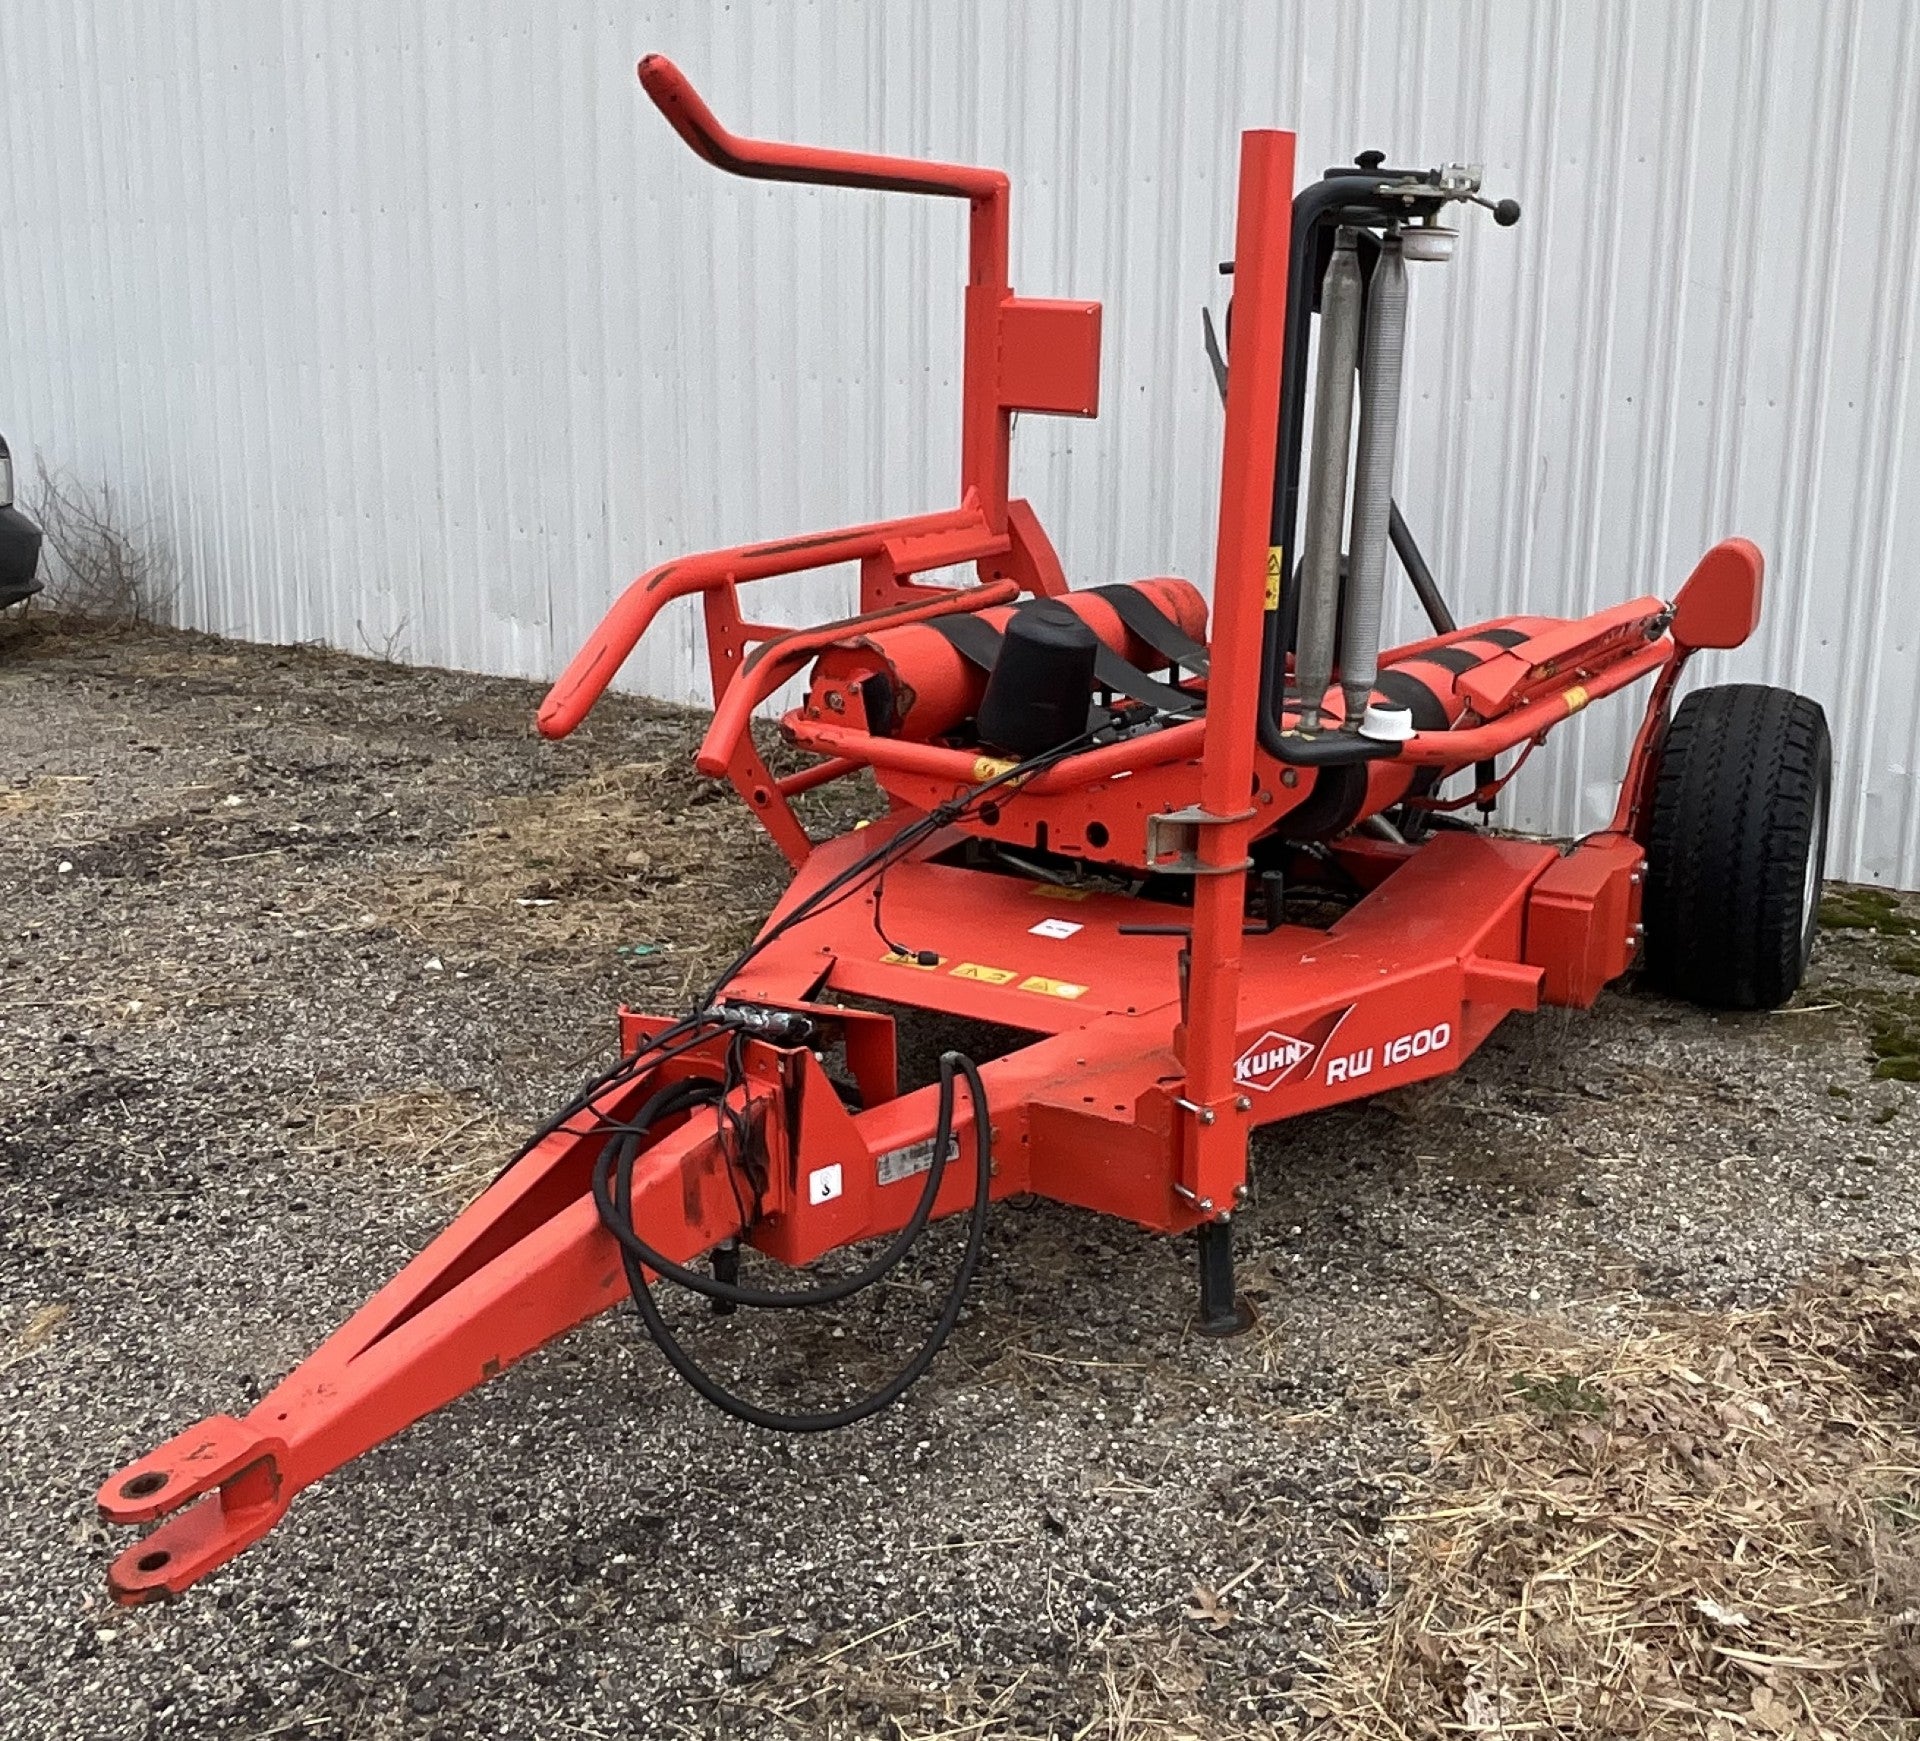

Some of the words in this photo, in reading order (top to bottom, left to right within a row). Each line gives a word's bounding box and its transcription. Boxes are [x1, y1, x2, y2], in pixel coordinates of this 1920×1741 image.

[1235, 1043, 1301, 1080] KUHN
[1326, 1048, 1373, 1086] RW
[1383, 1023, 1451, 1067] 1600
